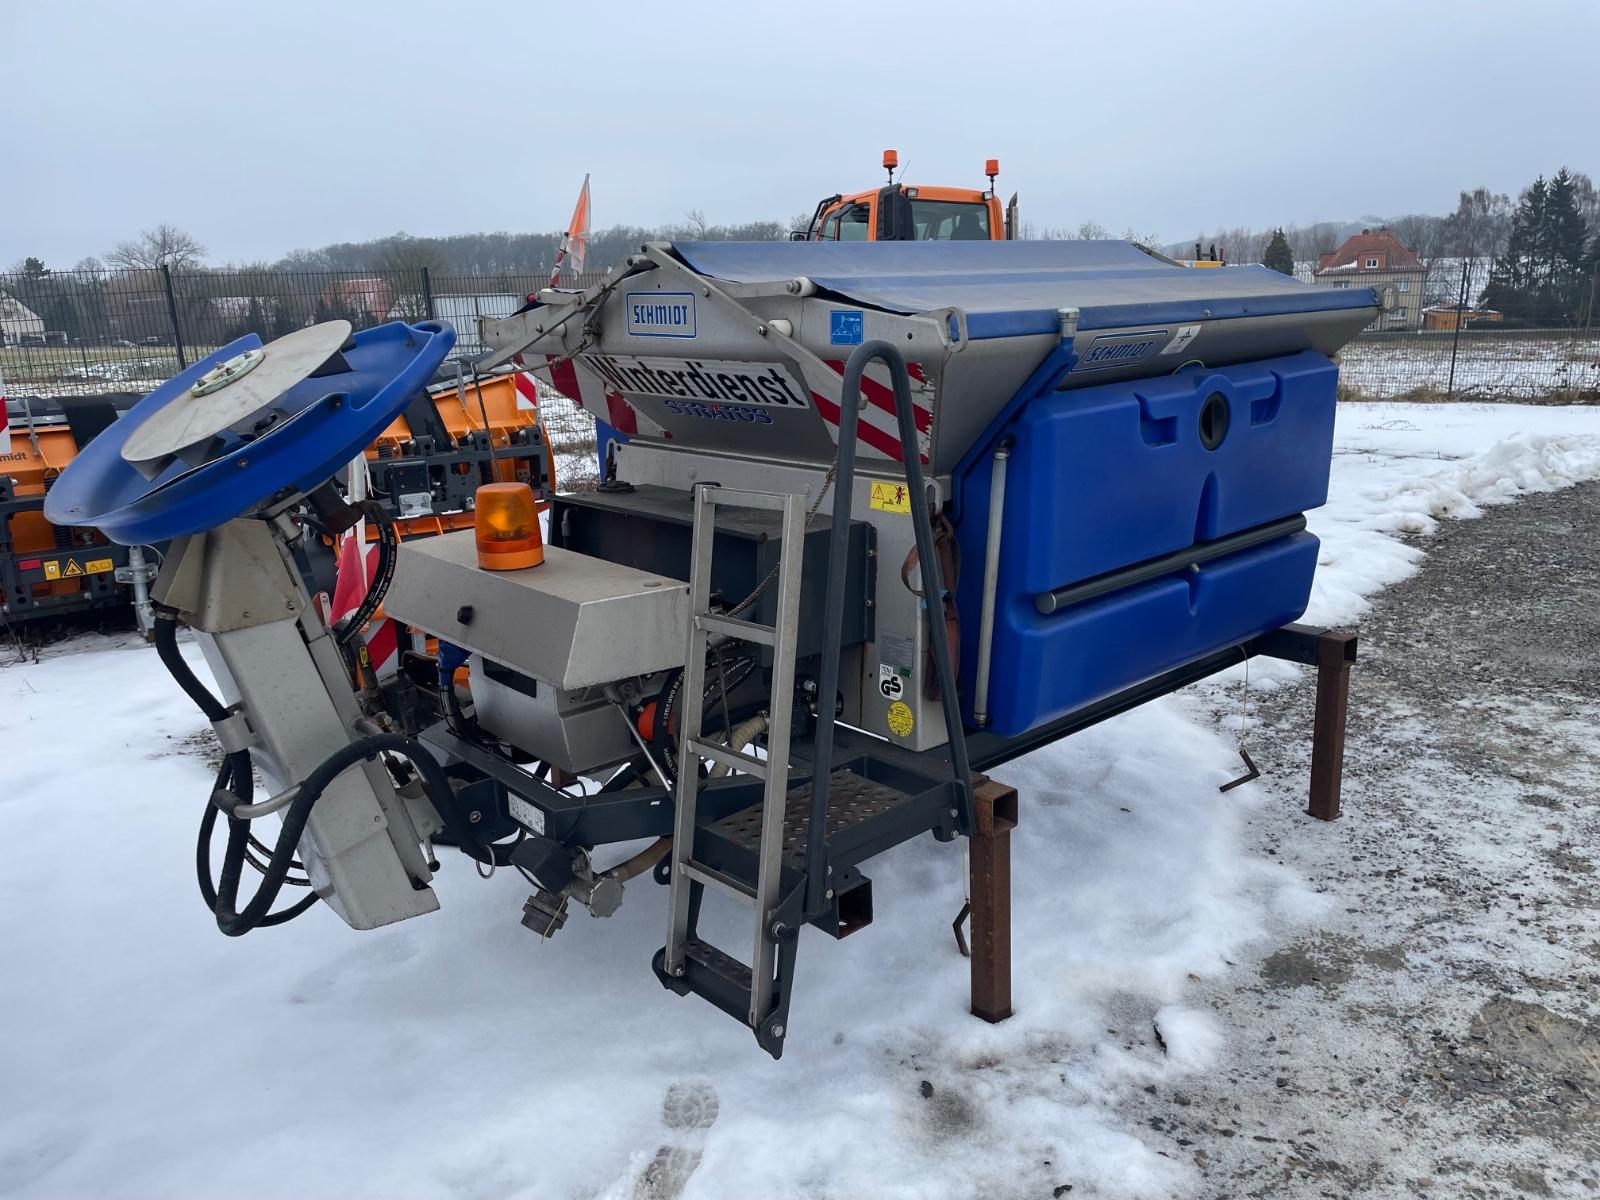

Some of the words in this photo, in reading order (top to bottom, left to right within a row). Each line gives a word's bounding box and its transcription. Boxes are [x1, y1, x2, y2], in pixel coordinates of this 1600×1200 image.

[633, 304, 688, 326] SCHMIDT
[1086, 342, 1155, 363] SCHMIDT
[585, 355, 806, 408] Winterdienst
[664, 399, 775, 425] STRATOS
[881, 676, 901, 696] GS
